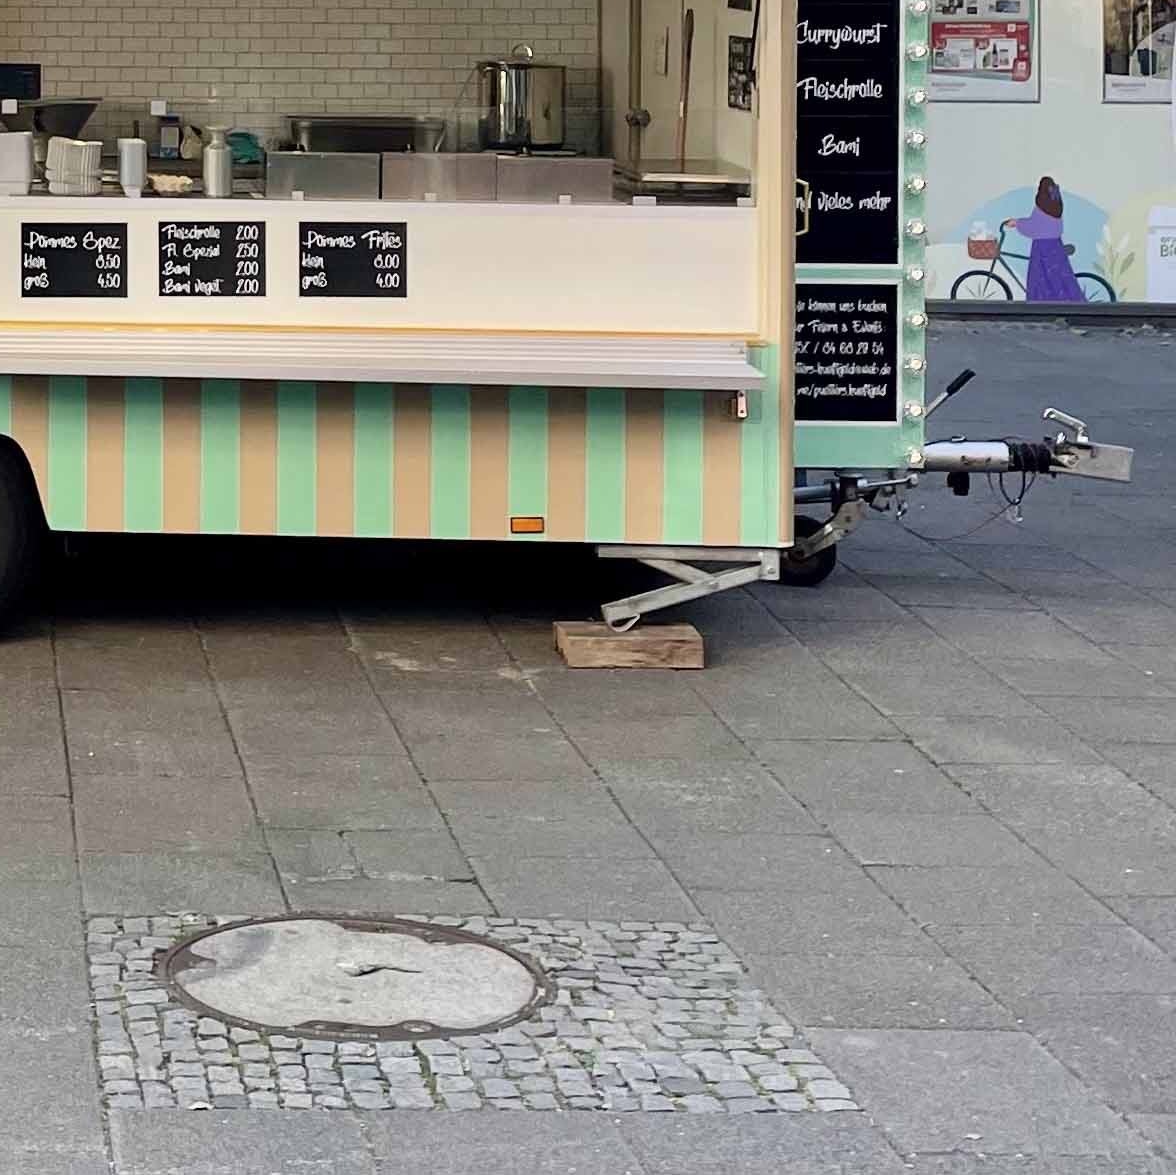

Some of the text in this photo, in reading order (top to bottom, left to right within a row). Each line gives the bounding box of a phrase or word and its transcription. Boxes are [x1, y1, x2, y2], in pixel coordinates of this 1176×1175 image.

[796, 76, 883, 101] Fleischrolle
[817, 134, 861, 157] Bami
[858, 190, 892, 211] mehr
[23, 230, 77, 250] Pommes
[302, 229, 402, 250] Pommes Frites
[162, 260, 191, 276] Bami
[23, 272, 49, 290] groß
[162, 278, 191, 294] Bami
[302, 271, 328, 290] groß
[839, 302, 855, 313] uns
